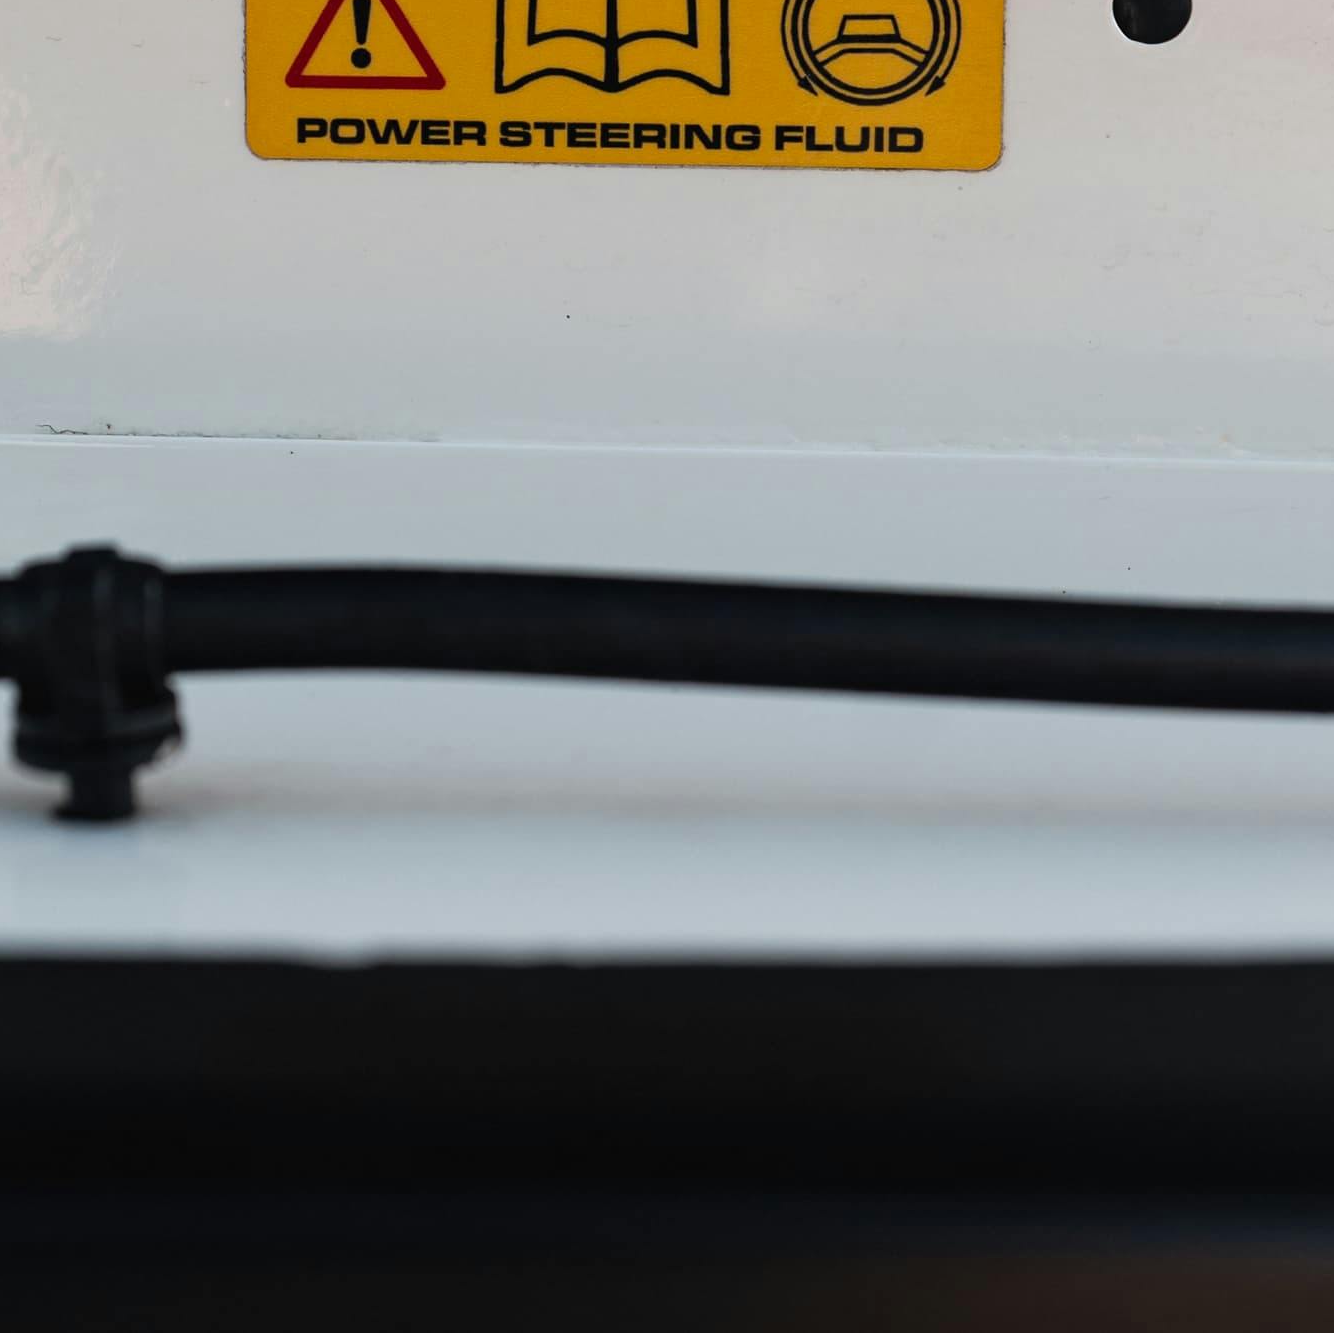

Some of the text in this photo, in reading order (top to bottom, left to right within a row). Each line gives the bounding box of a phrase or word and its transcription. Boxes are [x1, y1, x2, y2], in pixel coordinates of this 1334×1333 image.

[296, 117, 924, 153] POWER STEERING FLUID
